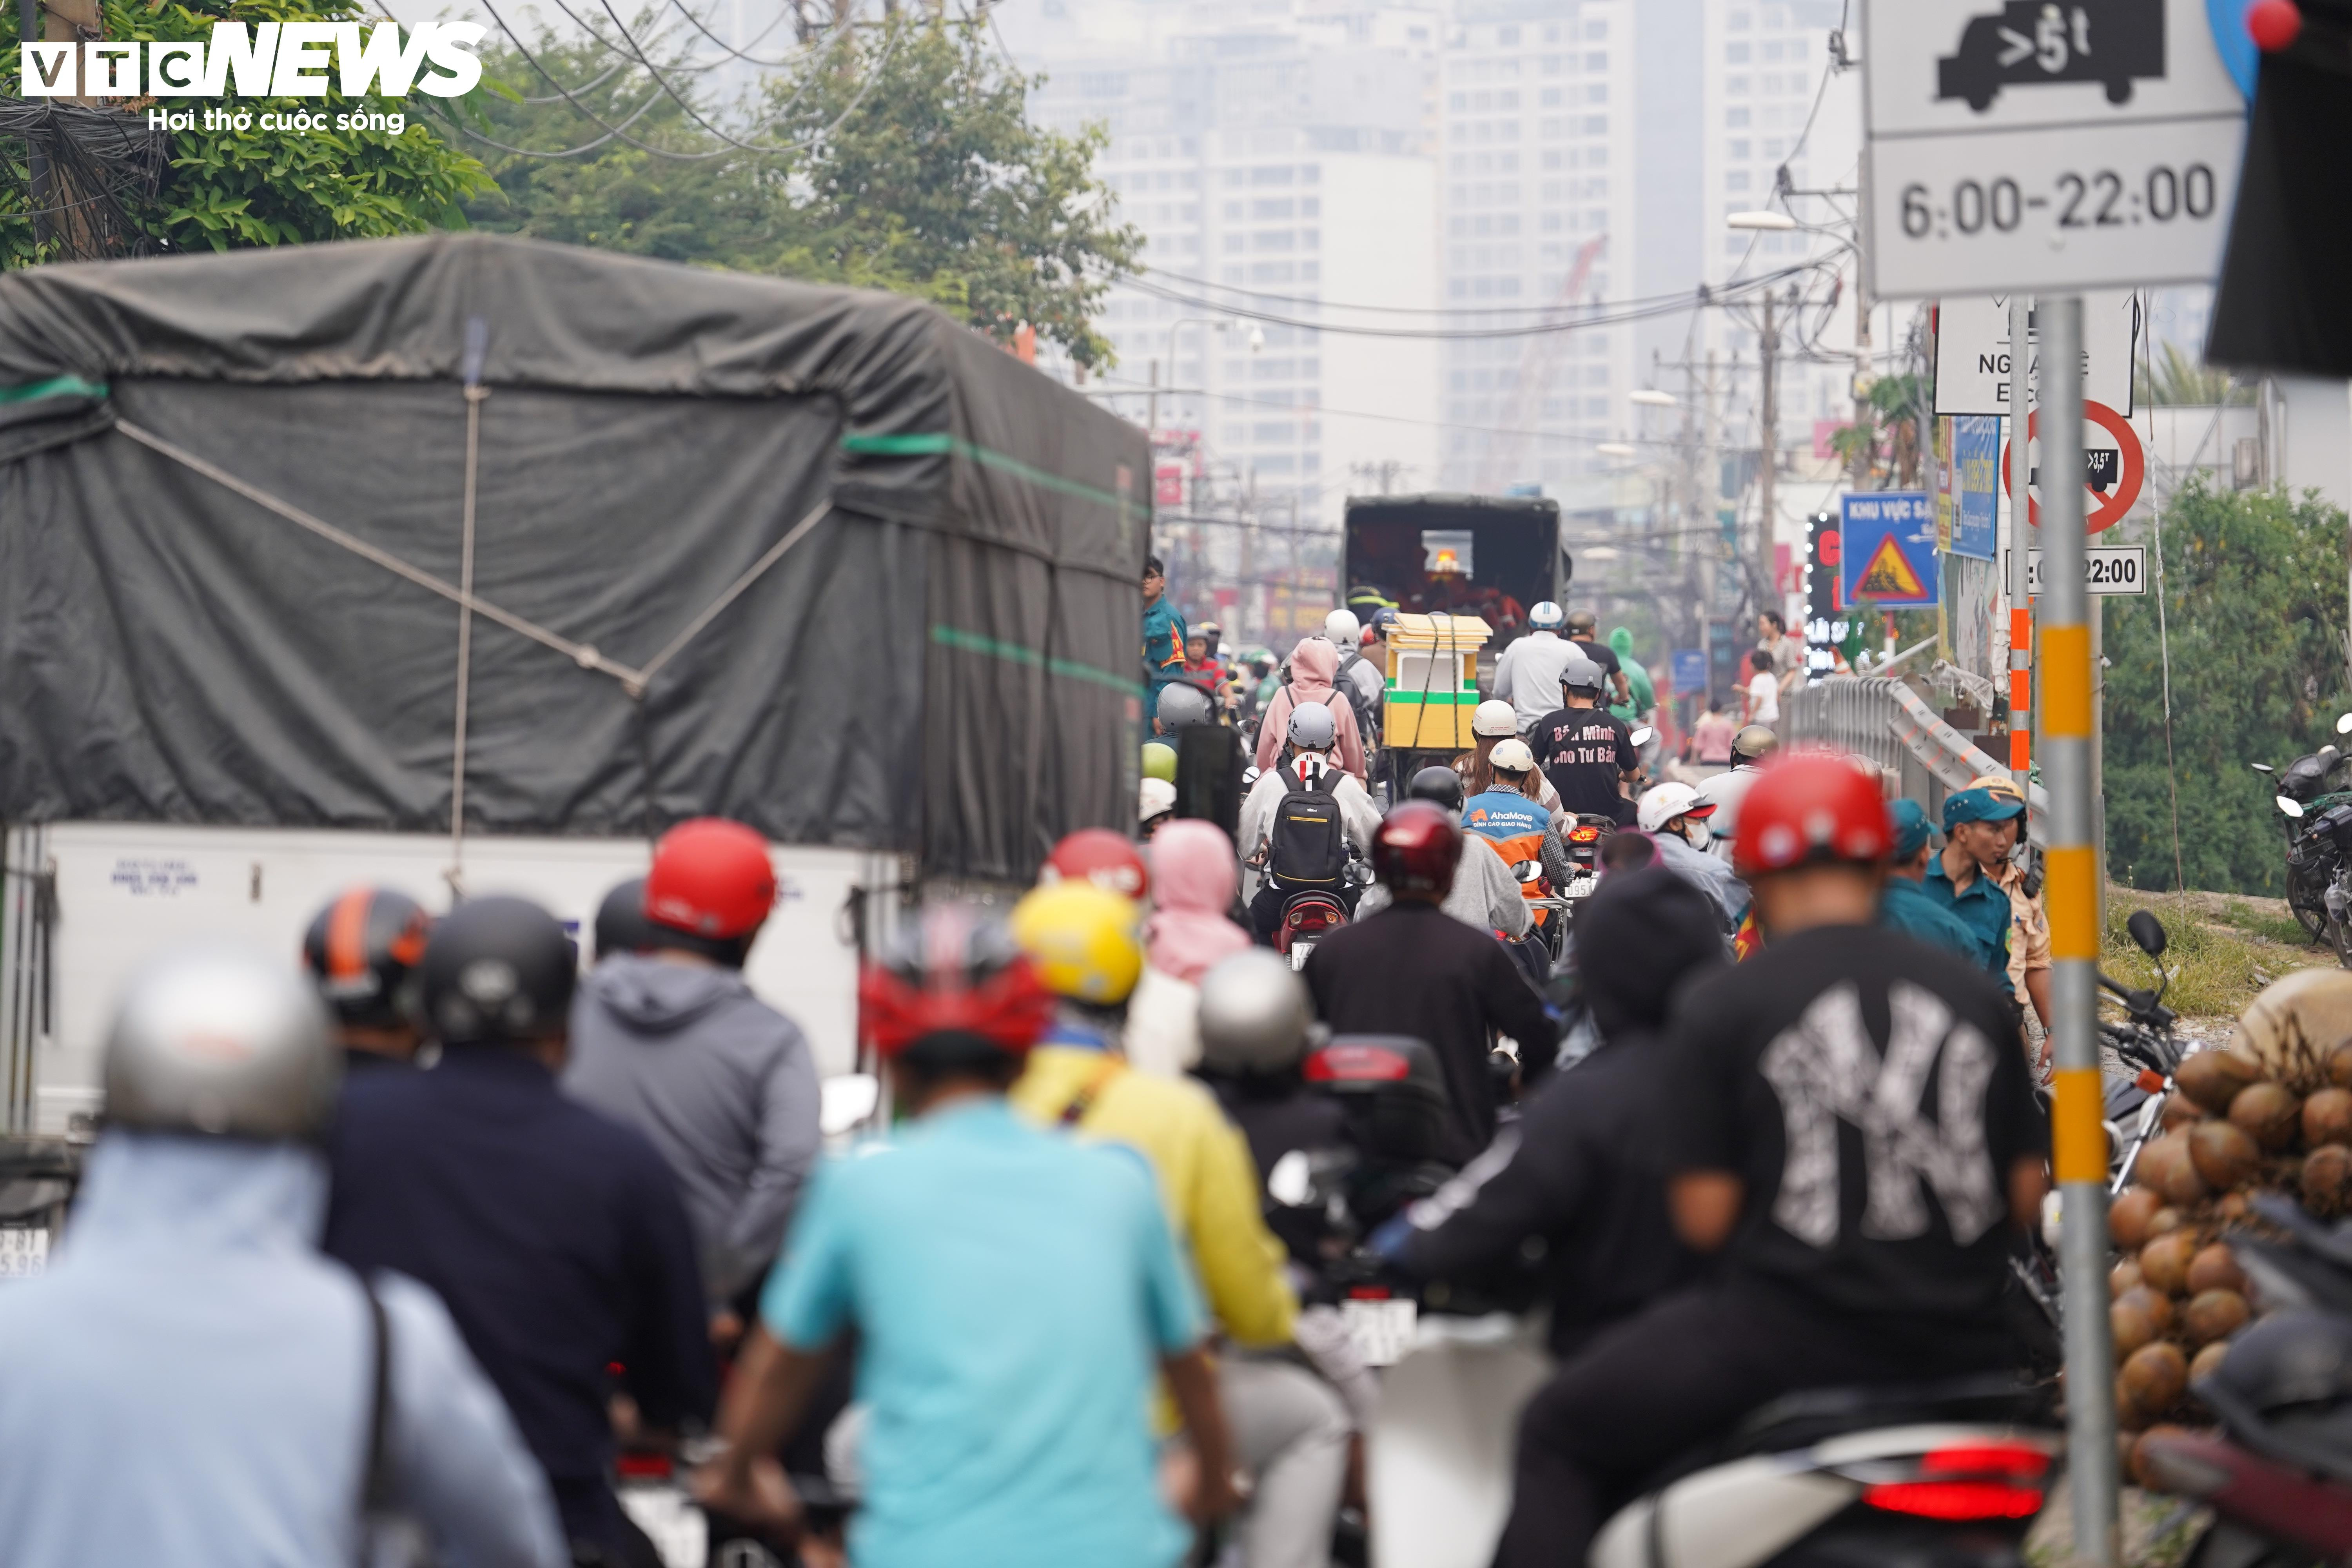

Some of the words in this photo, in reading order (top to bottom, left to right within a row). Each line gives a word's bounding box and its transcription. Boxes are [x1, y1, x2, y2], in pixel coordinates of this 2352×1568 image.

[1900, 162, 2217, 240] 6:00-22:00
[1849, 501, 1880, 520] KHU
[1882, 498, 1911, 524] VỰC
[1583, 724, 1615, 741] Mình
[1578, 747, 1595, 764] Tư
[1597, 745, 1616, 763] Bản
[1490, 812, 1533, 822] AhaMove
